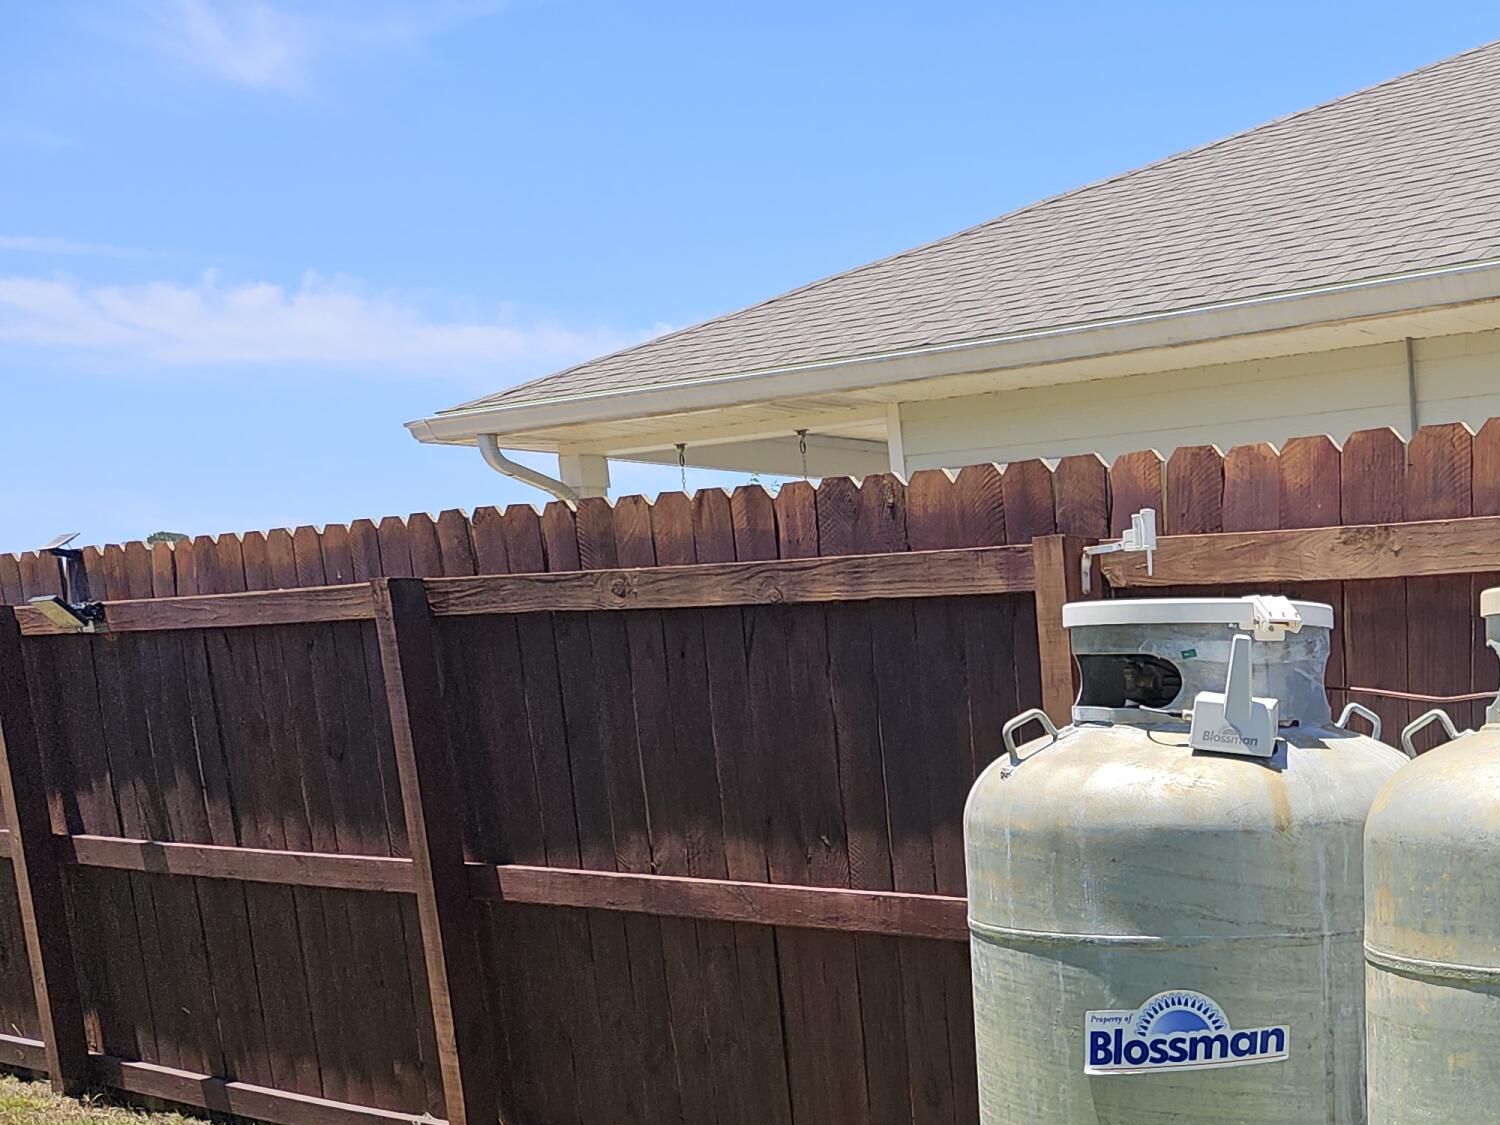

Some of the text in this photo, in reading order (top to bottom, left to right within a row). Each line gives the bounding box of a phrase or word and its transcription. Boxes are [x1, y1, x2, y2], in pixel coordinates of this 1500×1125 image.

[1202, 730, 1257, 745] Blossman
[1091, 1013, 1134, 1025] Property of
[1089, 1027, 1284, 1065] Blossman
